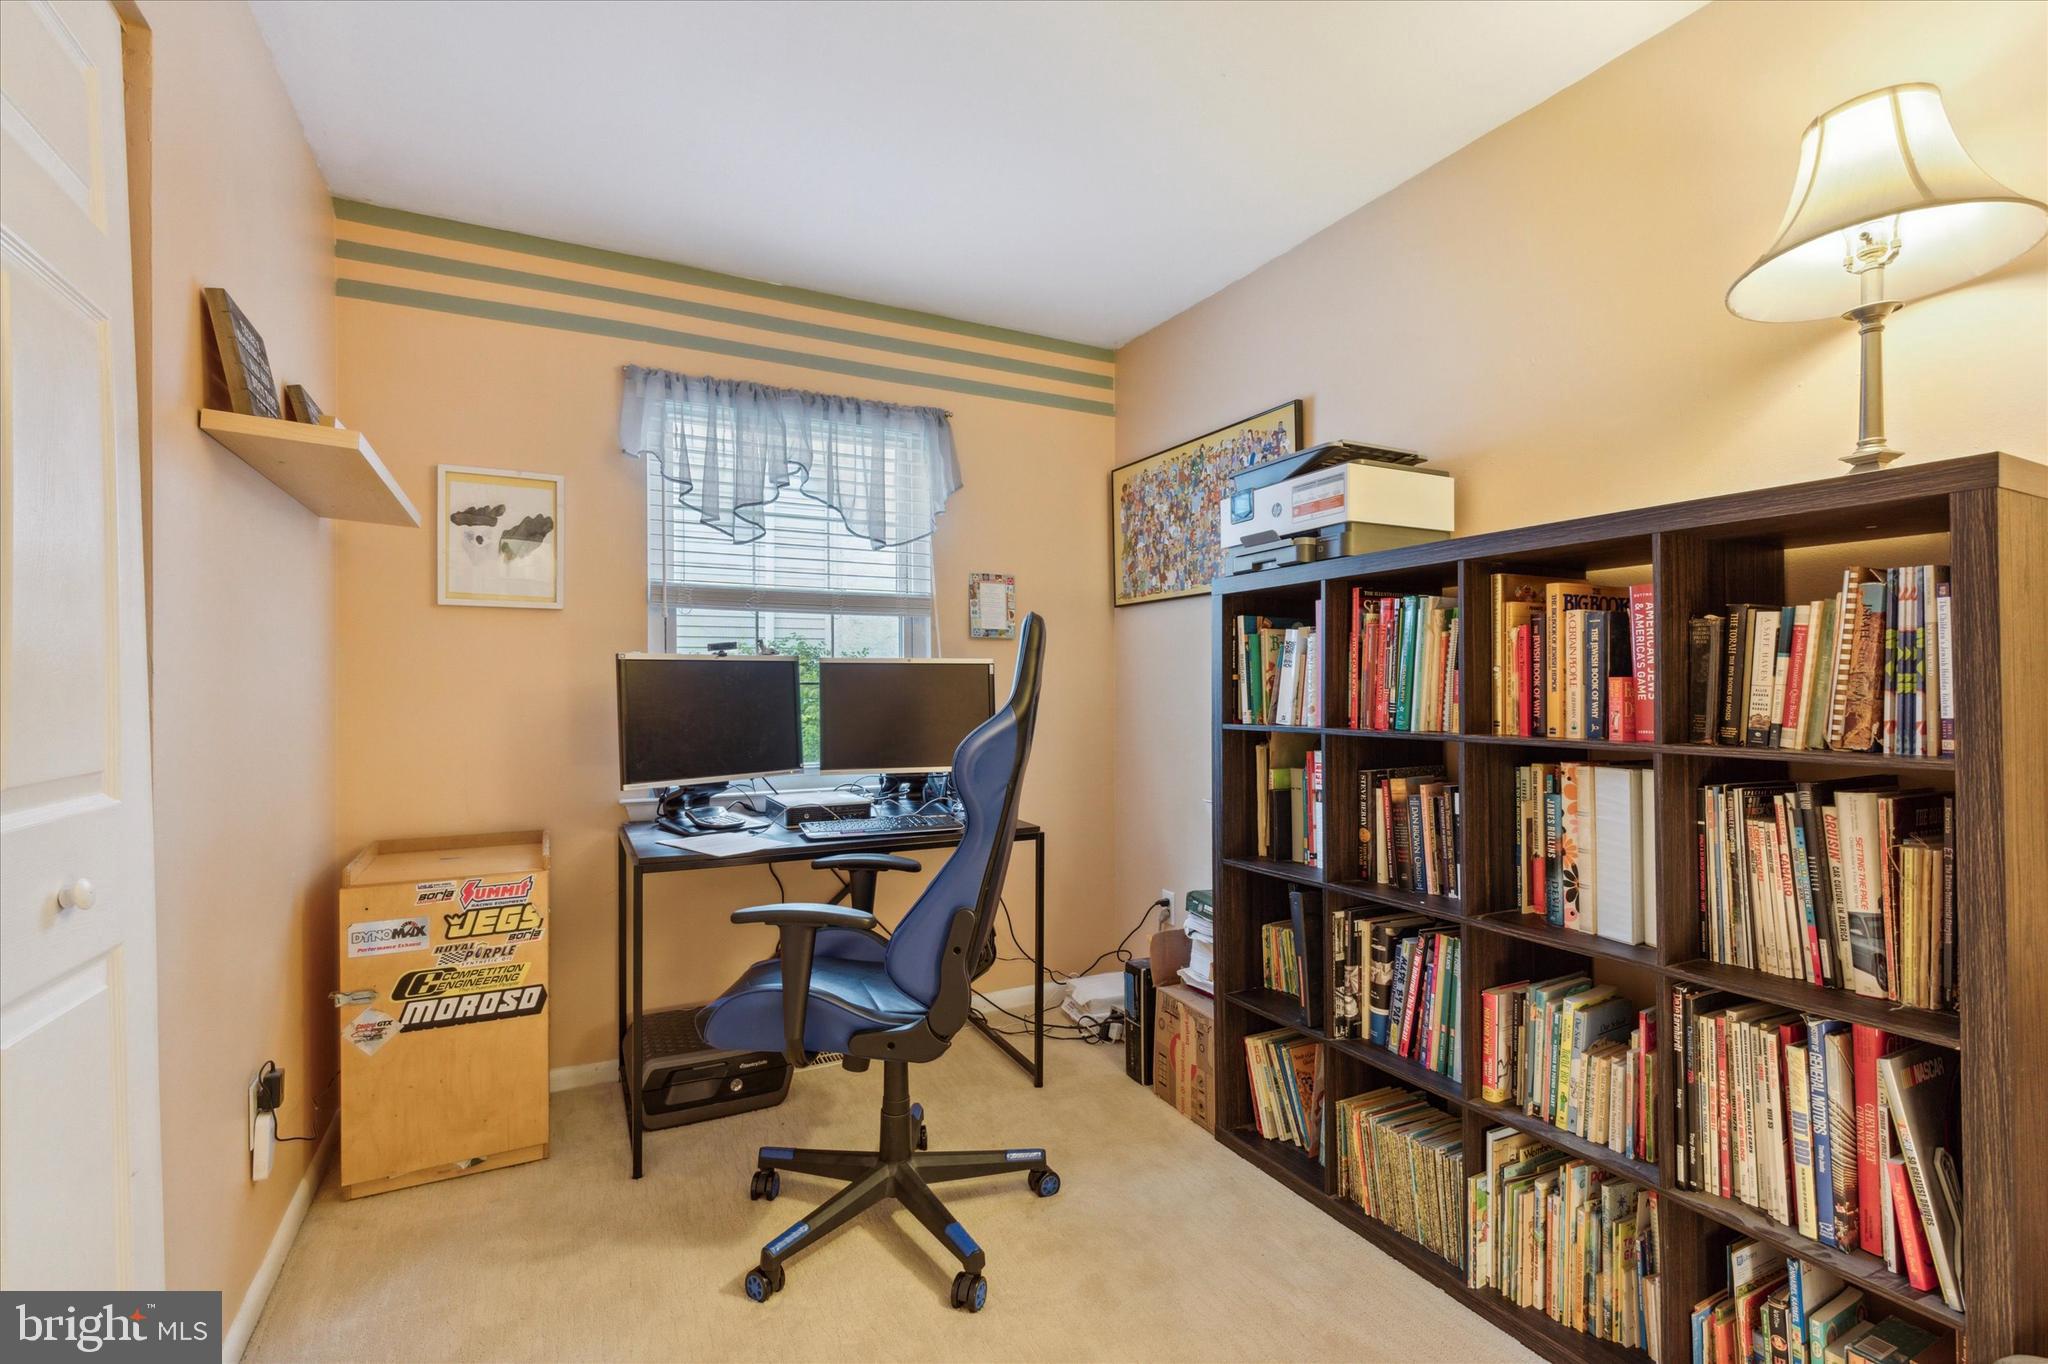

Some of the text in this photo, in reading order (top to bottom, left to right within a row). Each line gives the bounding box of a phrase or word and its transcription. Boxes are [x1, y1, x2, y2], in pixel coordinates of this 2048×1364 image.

[1564, 594, 1630, 612] BIG BOOK
[1634, 602, 1643, 611] &
[1940, 600, 1948, 611] The
[1645, 602, 1655, 663] AMERICAN
[1731, 612, 1739, 627] THE
[1861, 604, 1873, 640] ISRAEL
[1940, 612, 1950, 644] Children's
[1533, 635, 1541, 661] JEWISH
[1569, 619, 1577, 652] CERTAIN
[1634, 613, 1646, 668] AMERICA'S
[1729, 628, 1738, 654] TORAH
[1760, 616, 1771, 682] A SAFE HAVEN
[1795, 632, 1804, 651] Jewish
[1533, 663, 1541, 686] BOOK
[1570, 657, 1579, 688] PEOPLE
[1591, 628, 1599, 719] THE JEWISH BOOK OF WHY
[1791, 652, 1803, 689] Information
[1533, 688, 1541, 699] OF
[1637, 671, 1647, 700] GAME
[1533, 700, 1541, 718] WHY
[1360, 774, 1369, 827] STEVE BERRY
[1411, 806, 1419, 824] DAN
[1412, 825, 1420, 854] BROWN
[1547, 798, 1556, 858] JAMES ROLLINS
[1824, 814, 1841, 864] CRUISIN'
[1780, 853, 1792, 896] CAMARO
[1832, 866, 1840, 878] CAR
[1856, 837, 1869, 911] SETTING THE PACE
[1551, 880, 1560, 913] DEVIL
[1833, 880, 1843, 905] CULTURE
[351, 924, 428, 945] DYNOMAX
[444, 903, 543, 940] JEGS
[1838, 915, 1848, 942] AMERICA
[434, 942, 477, 954] ROYAL
[437, 973, 521, 990] ENGINEERING
[441, 964, 525, 981] COMPETITION
[401, 987, 542, 1026] MOROSO
[376, 1020, 394, 1028] GTX
[1402, 1009, 1413, 1041] Broadcast
[1672, 993, 1683, 1052] Dale Earnhardt
[1562, 1049, 1571, 1068] TURTLE
[1809, 1052, 1824, 1092] GENERAL
[1914, 1056, 1945, 1084] NASCAR
[1560, 1072, 1569, 1086] BOY
[1719, 1070, 1728, 1132] CHEVROLET
[1811, 1094, 1827, 1136] MOTORS
[1792, 1110, 1807, 1135] HOT
[1856, 1105, 1865, 1155] CHRONICLE
[1864, 1102, 1876, 1164] CHEVROLET
[1795, 1139, 1810, 1166] ROD
[1909, 1166, 1925, 1197] GREATEST
[1919, 1198, 1934, 1227] DRIVERS
